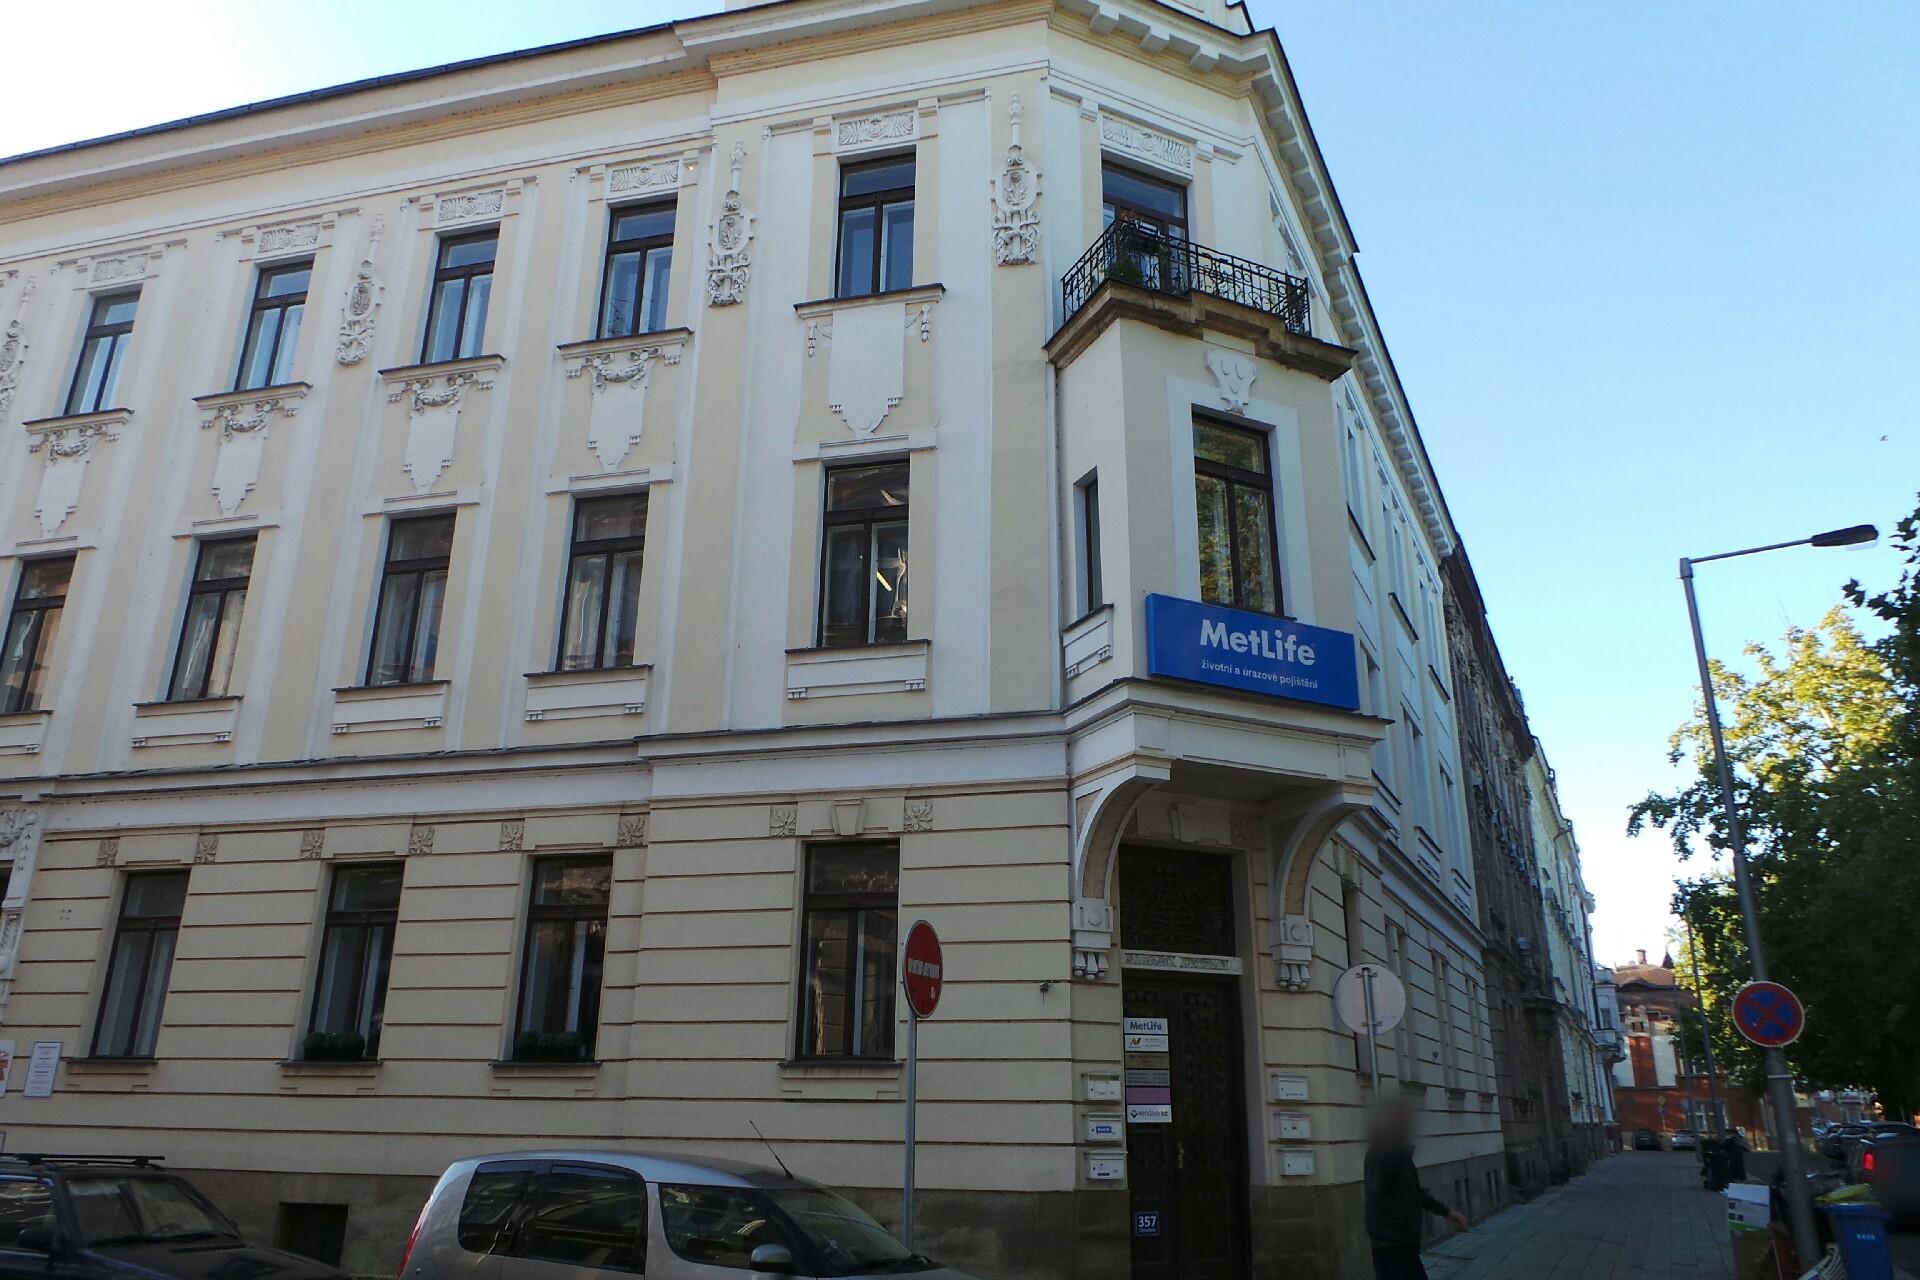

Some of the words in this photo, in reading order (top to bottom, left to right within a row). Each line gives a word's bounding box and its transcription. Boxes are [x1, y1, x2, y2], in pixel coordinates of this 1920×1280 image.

[1200, 619, 1316, 666] MetLife
[1201, 659, 1233, 675] životní
[1234, 667, 1241, 675] a
[1242, 667, 1278, 682] úrazové
[1280, 674, 1318, 689] pojištění
[1129, 1020, 1162, 1031] MetLife
[1138, 1215, 1157, 1228] 357
